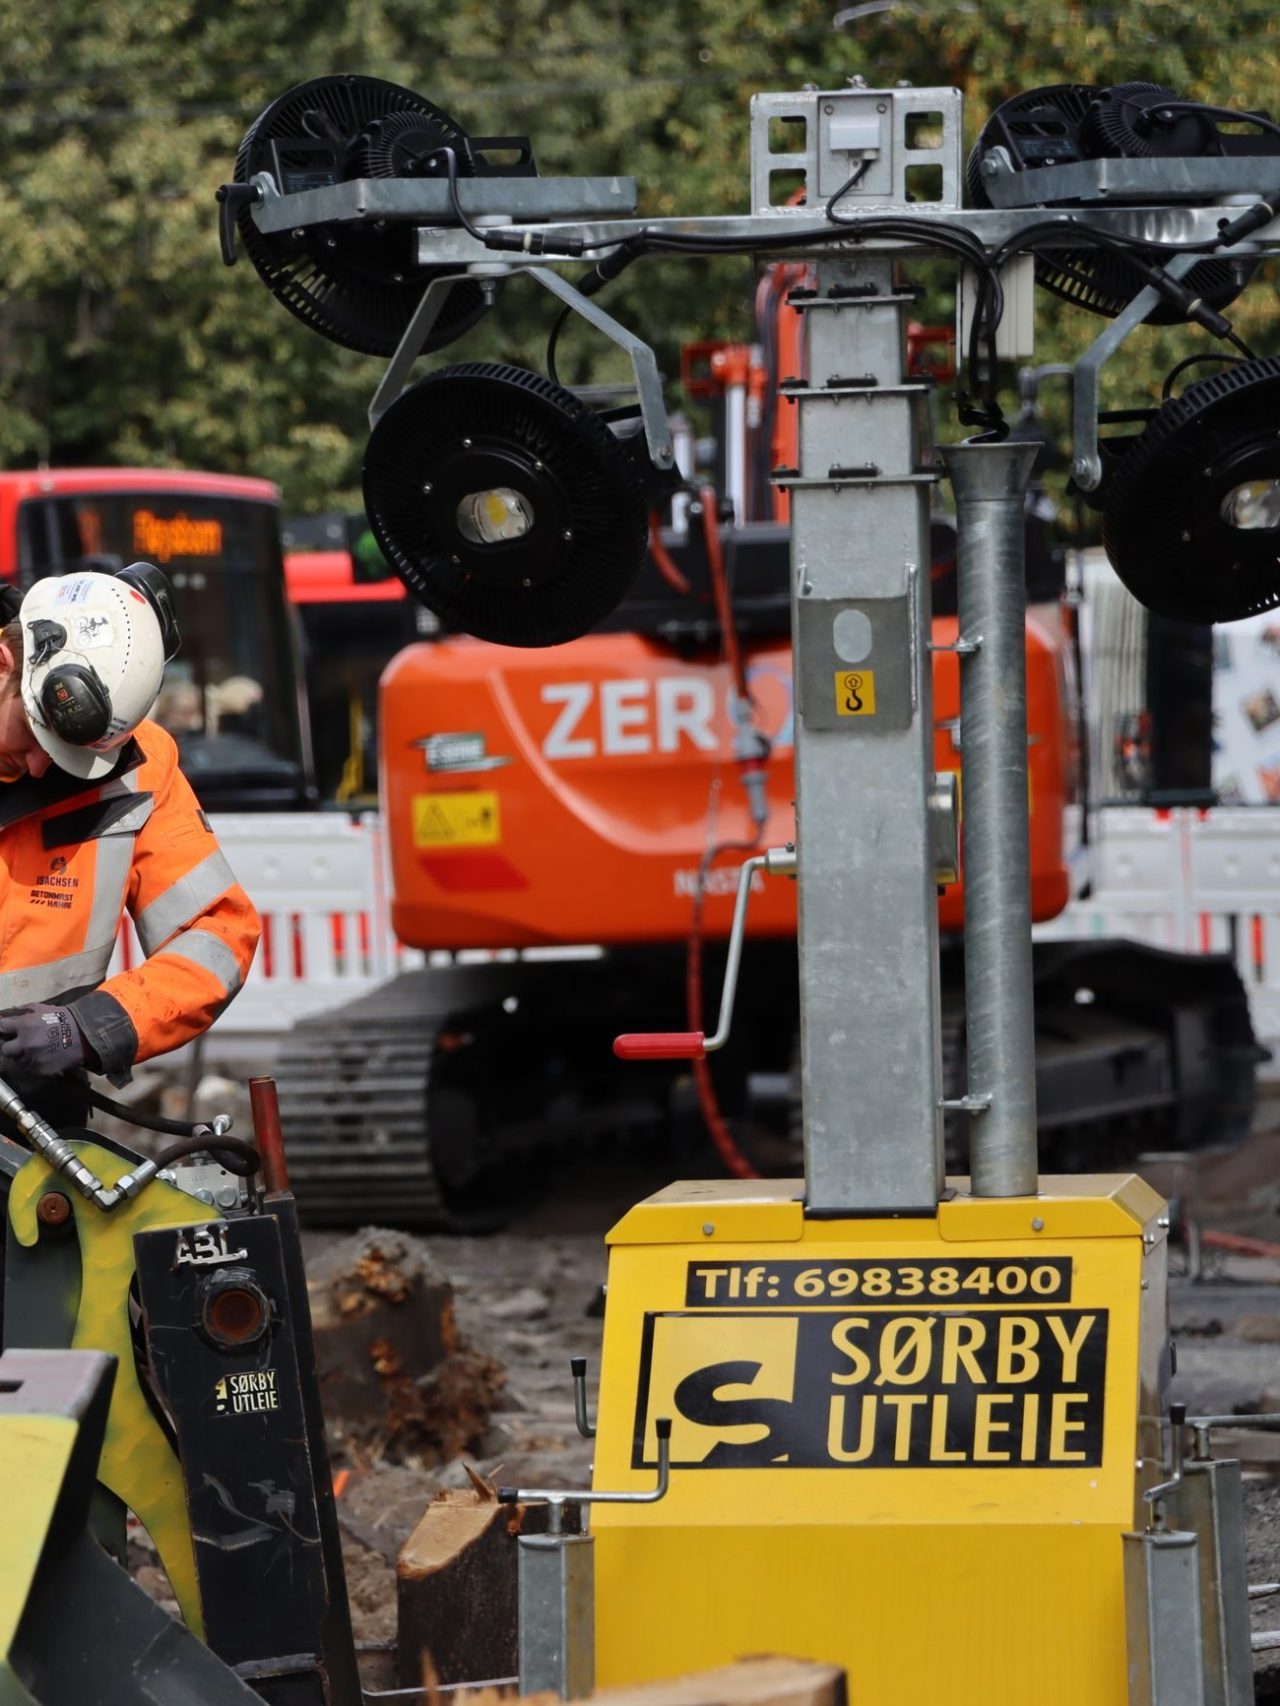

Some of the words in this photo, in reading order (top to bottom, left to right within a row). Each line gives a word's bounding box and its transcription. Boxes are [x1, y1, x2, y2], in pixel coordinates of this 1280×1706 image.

[36, 875, 79, 888] ISACHSEN
[695, 1266, 779, 1299] Tlf:
[793, 1264, 1062, 1298] 69838400
[830, 1314, 1097, 1387] SØRBY
[230, 1371, 275, 1394] SØRBY
[232, 1390, 279, 1413] UTLEIE
[826, 1392, 1090, 1463] UTLEIE
